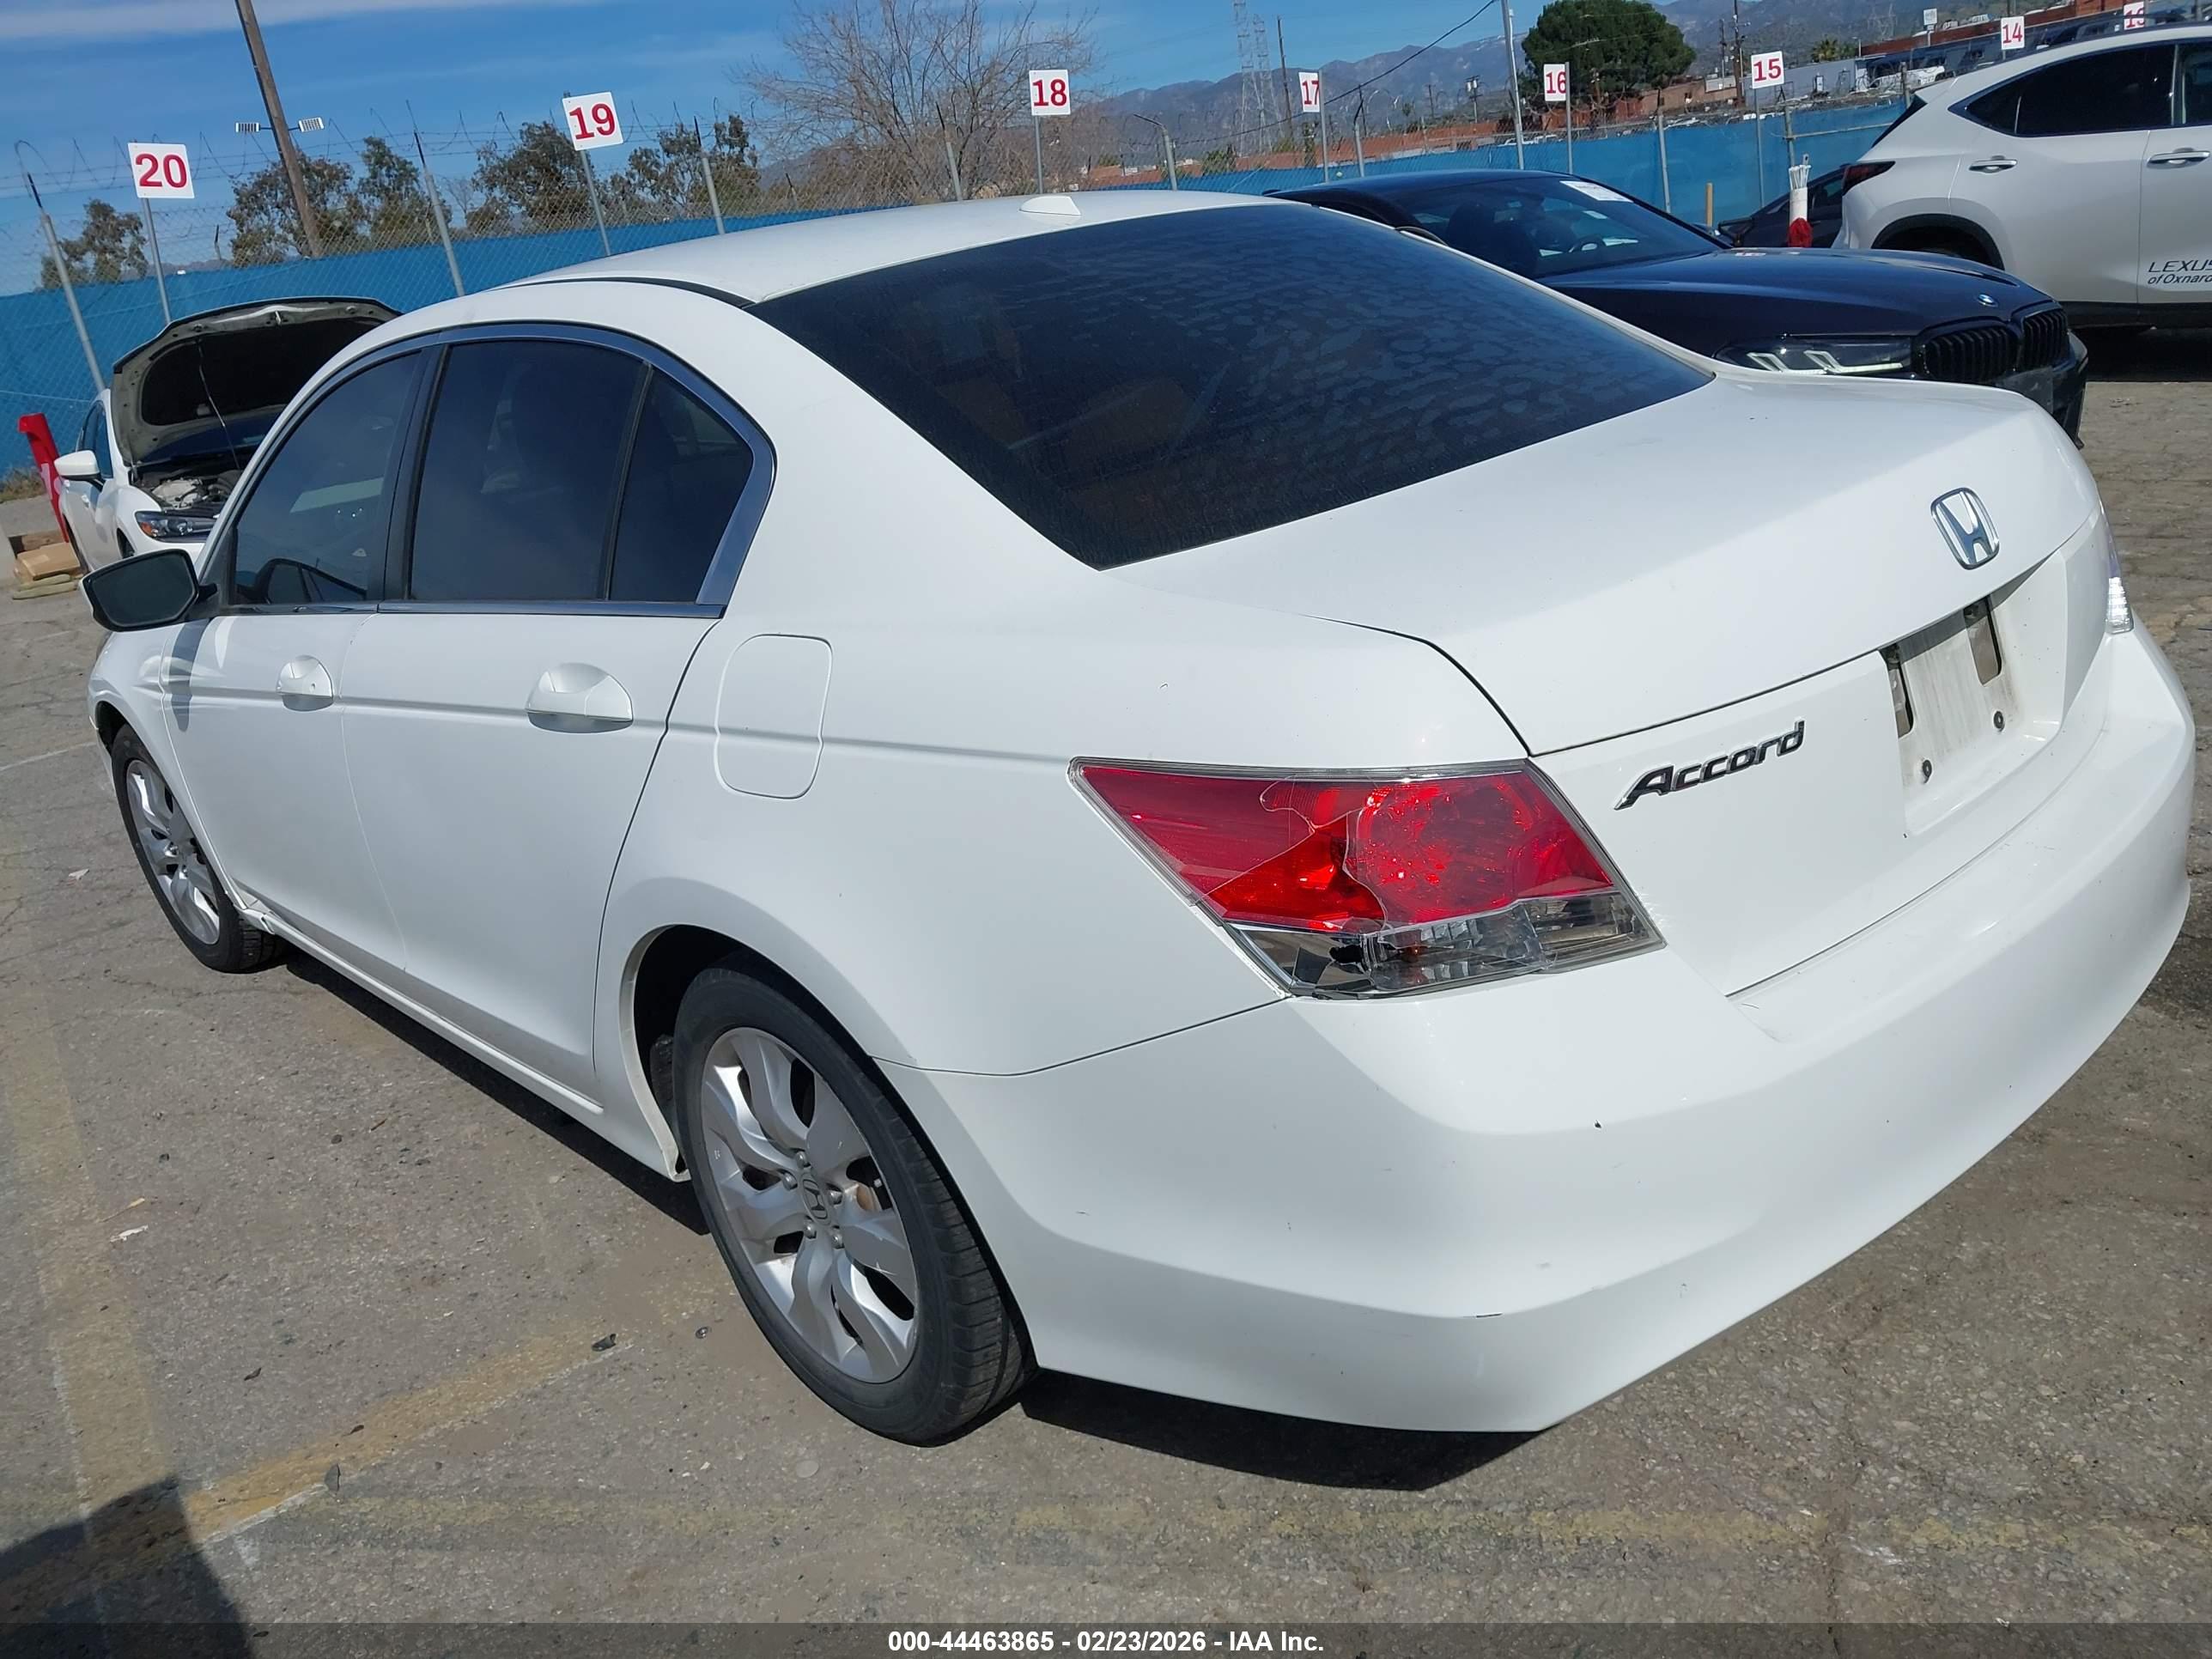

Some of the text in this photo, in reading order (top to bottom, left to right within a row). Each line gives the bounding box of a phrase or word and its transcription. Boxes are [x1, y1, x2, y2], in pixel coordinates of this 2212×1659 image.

[2002, 22, 2023, 44] 14
[1753, 58, 1782, 82] 15
[1032, 78, 1067, 106] 18
[569, 103, 616, 140] 19
[135, 153, 187, 188] 20
[2148, 274, 2164, 285] of
[1613, 720, 1806, 811] Accord
